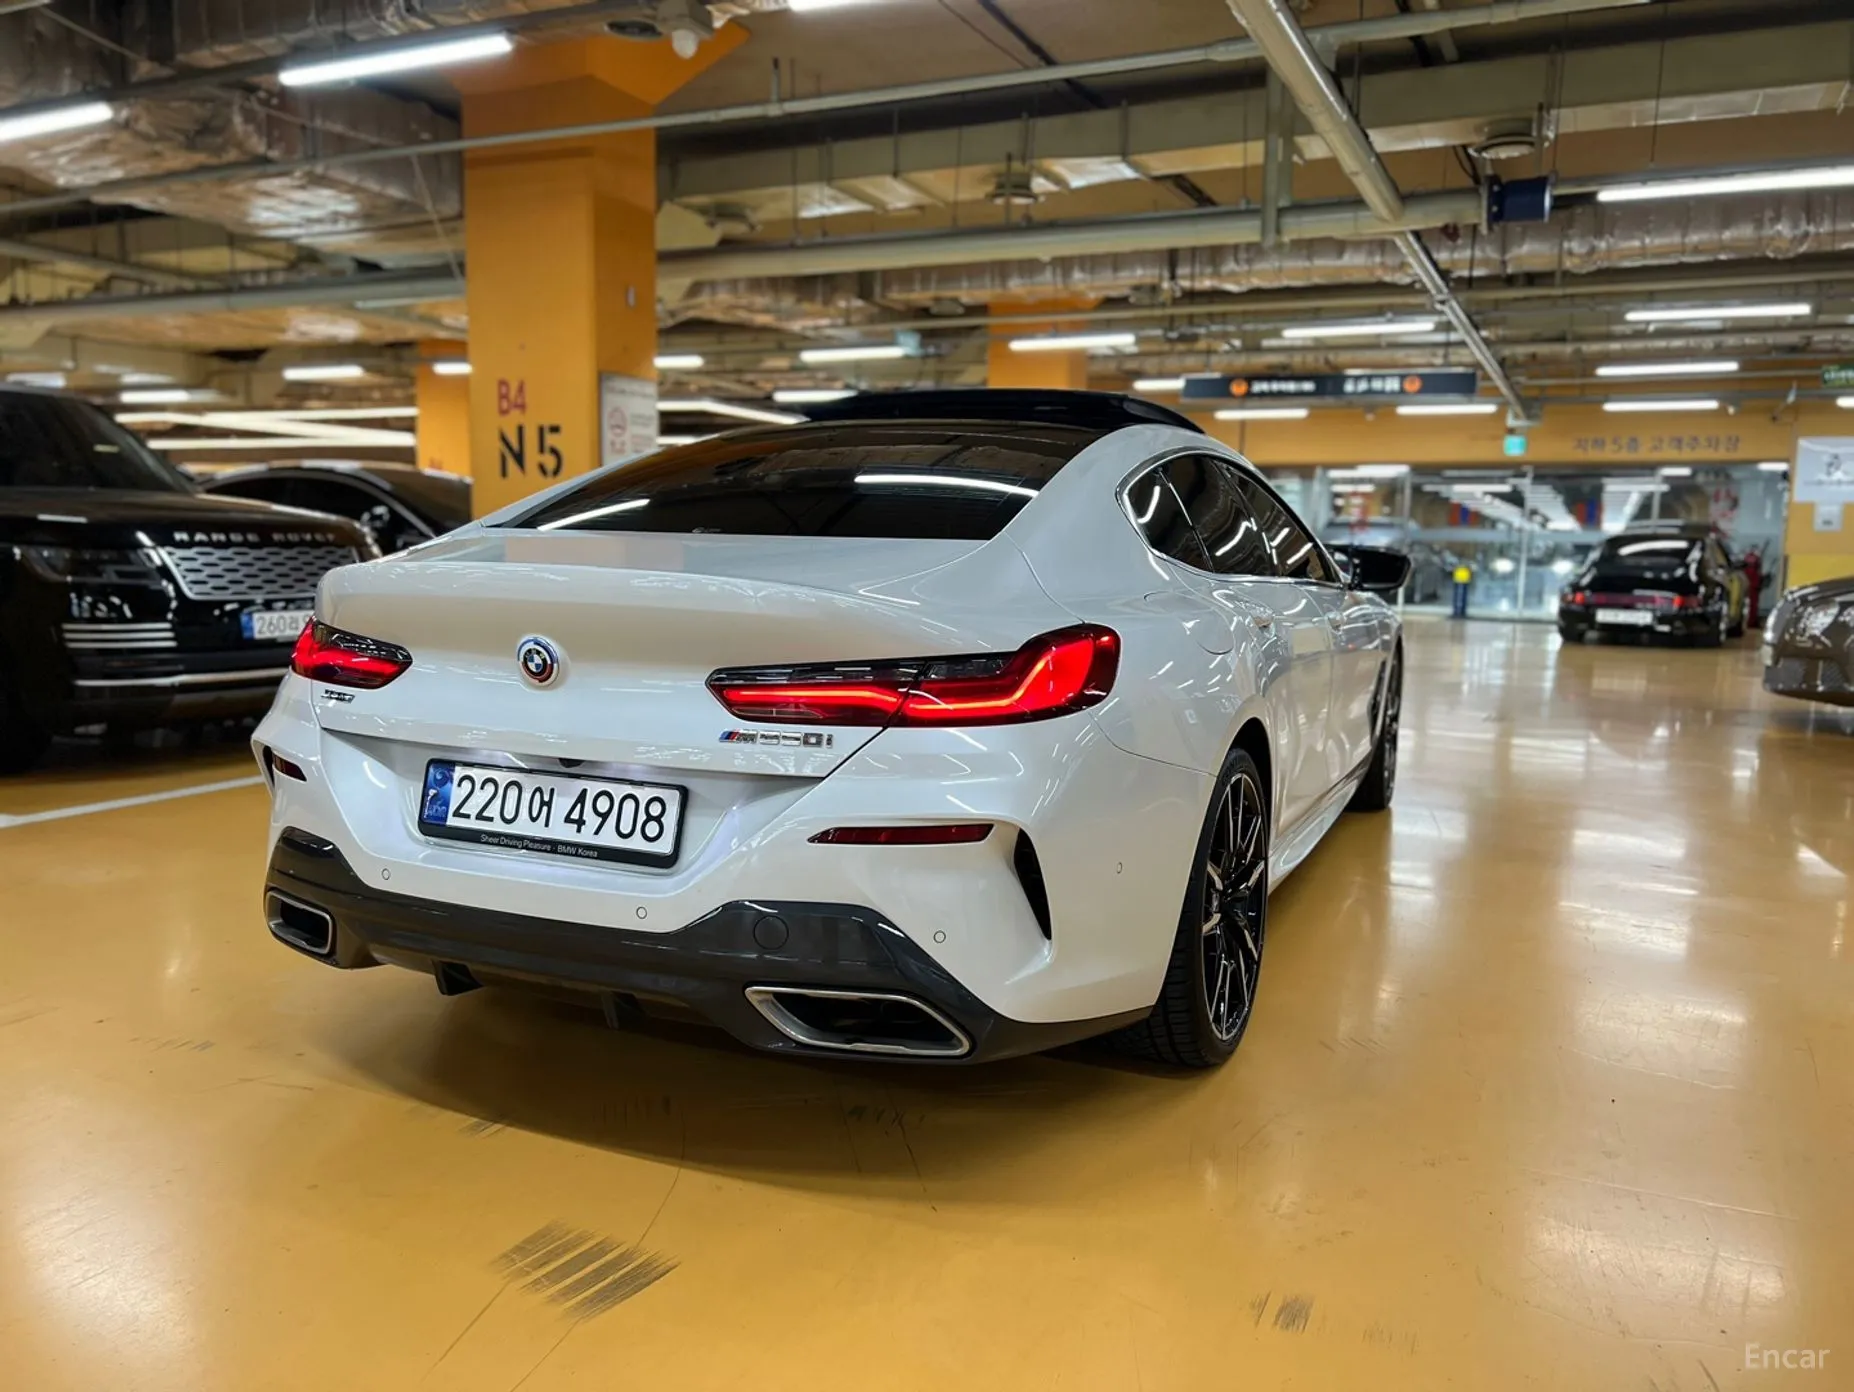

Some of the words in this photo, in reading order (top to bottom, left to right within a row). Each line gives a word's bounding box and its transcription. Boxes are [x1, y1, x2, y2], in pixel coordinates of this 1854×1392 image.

[498, 379, 526, 416] B4
[173, 532, 260, 542] RANGE
[452, 774, 555, 828] 220어
[564, 787, 667, 843] 4908
[480, 834, 500, 845] Sheer
[500, 836, 523, 848] Driving
[523, 839, 552, 851] Pleasure
[557, 844, 577, 853] BMW
[577, 846, 598, 858] Korea
